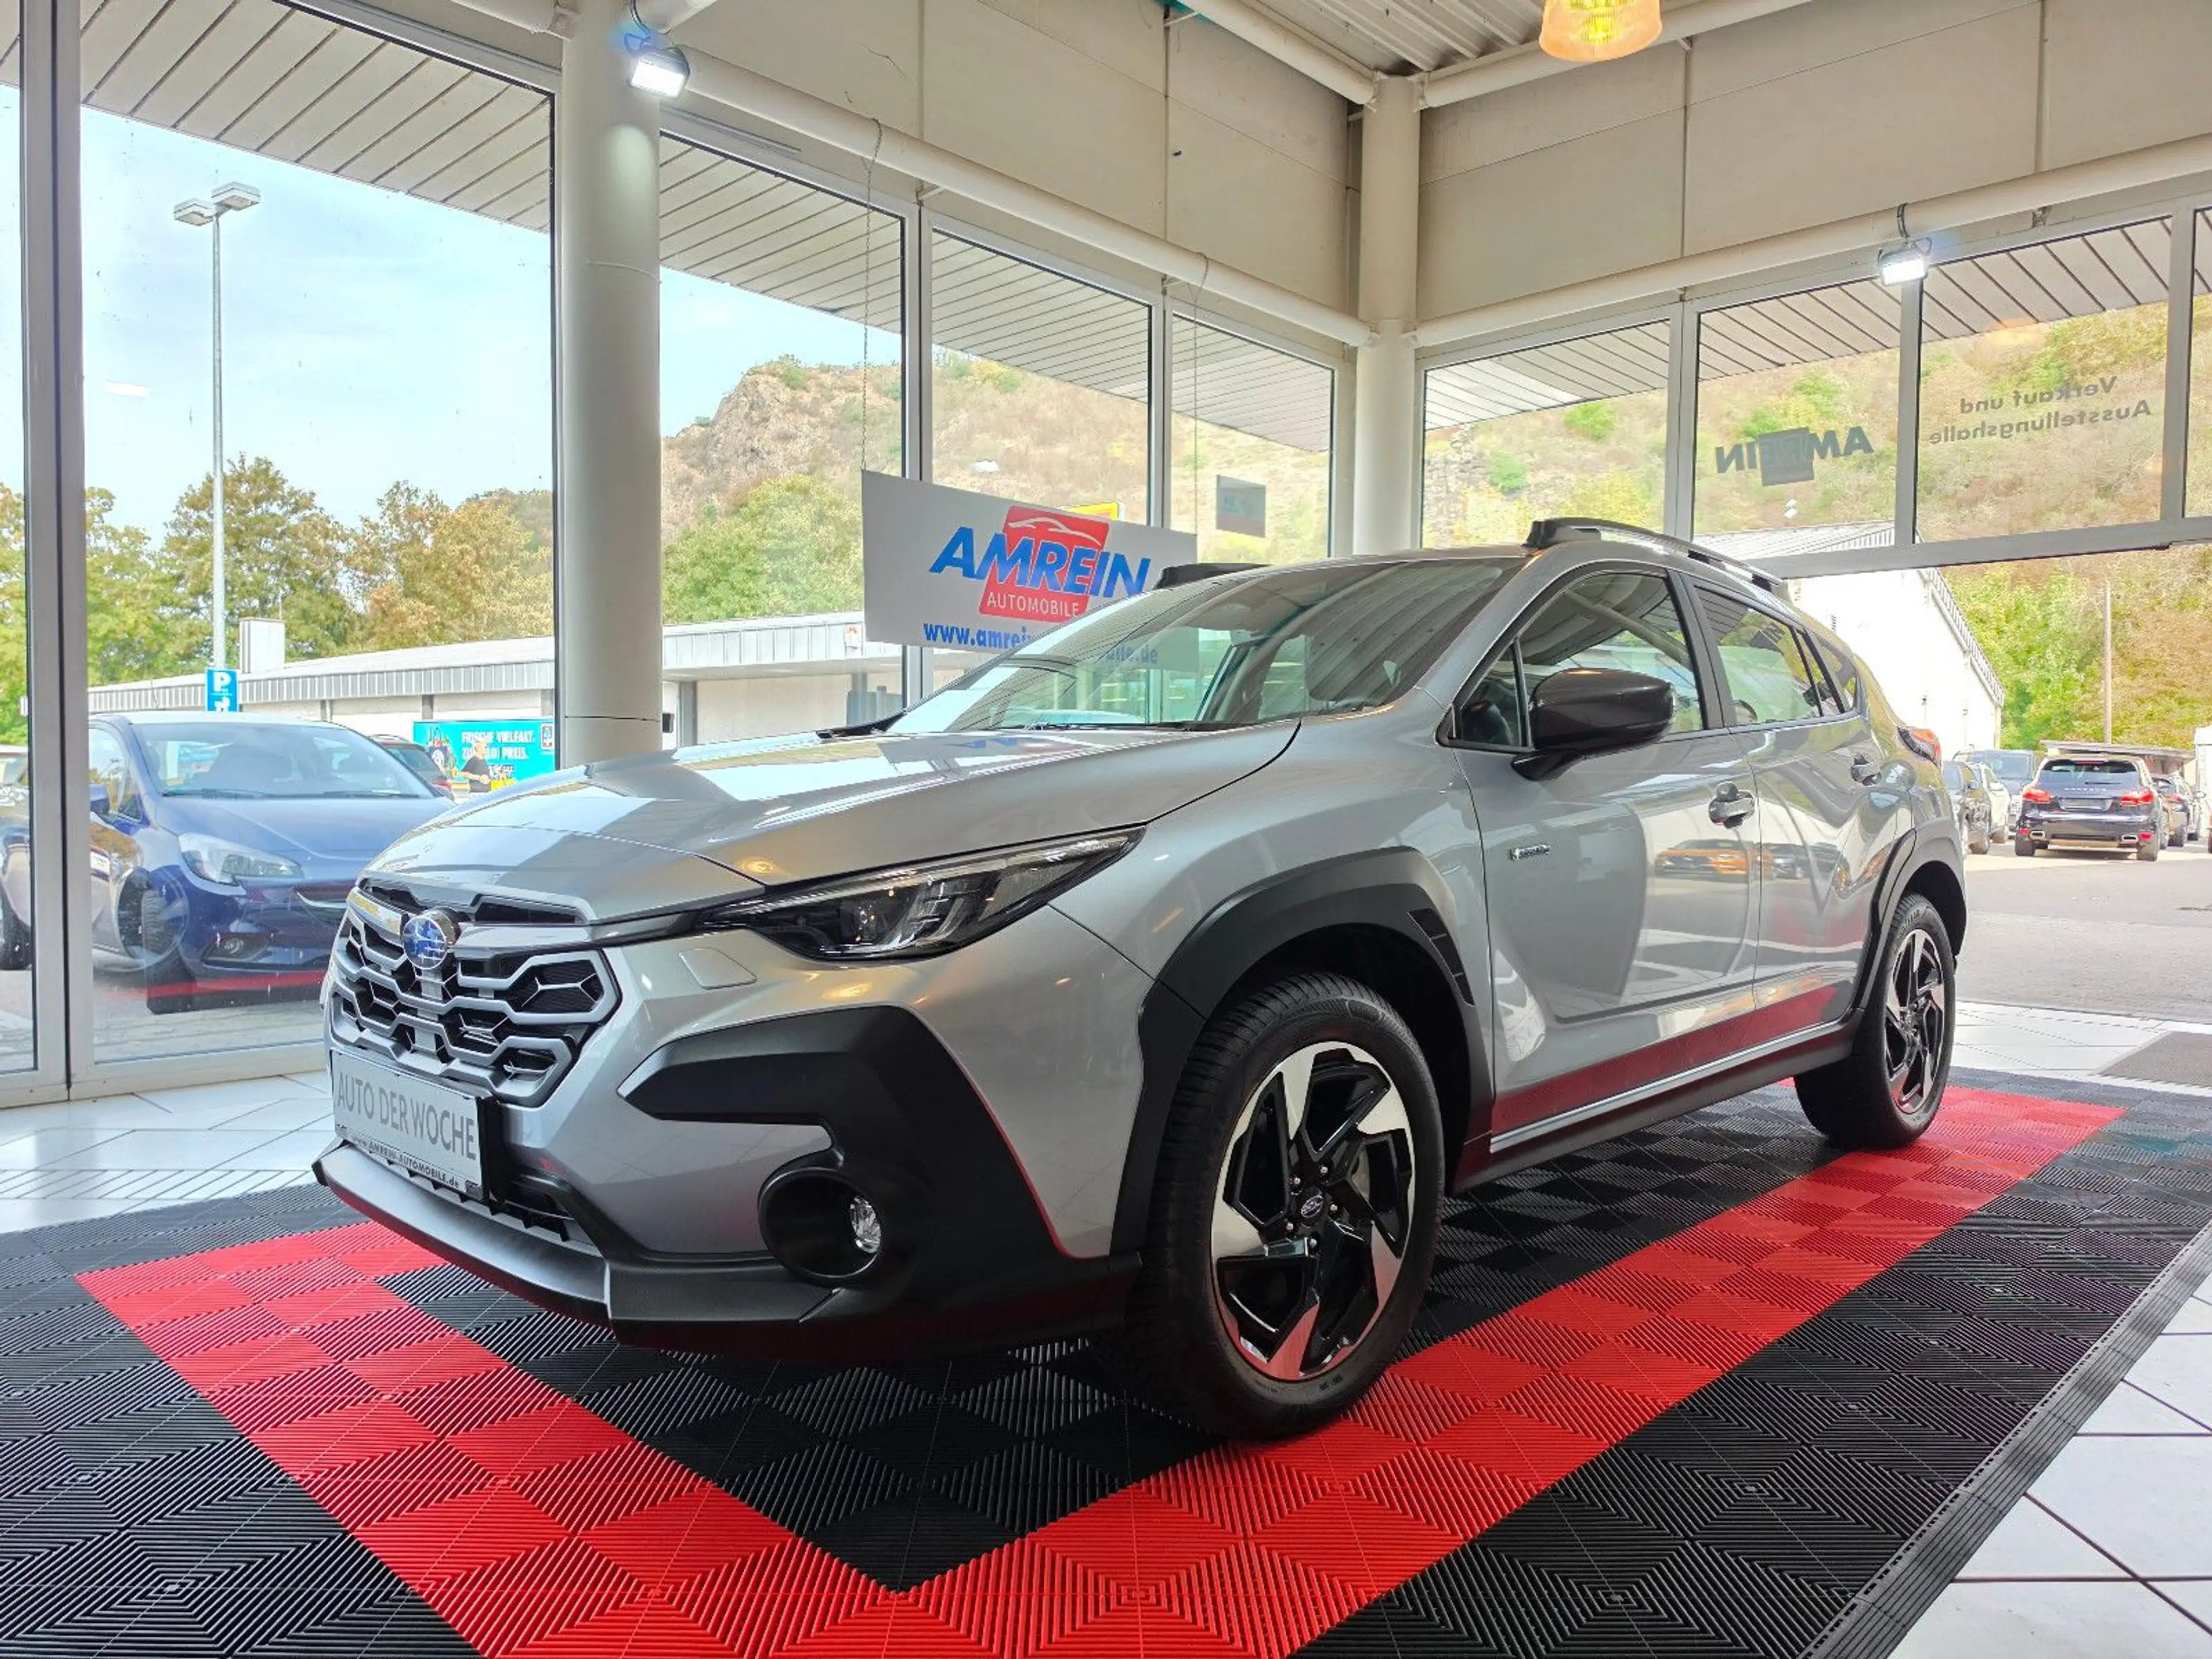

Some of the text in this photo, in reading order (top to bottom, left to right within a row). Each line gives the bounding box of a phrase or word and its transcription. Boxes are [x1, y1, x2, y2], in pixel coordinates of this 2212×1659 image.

[929, 526, 1152, 598] AMREIN
[987, 591, 1080, 618] AUTOMOBILE
[213, 672, 232, 692] P
[337, 1071, 476, 1161] AUTO DER WOCHE
